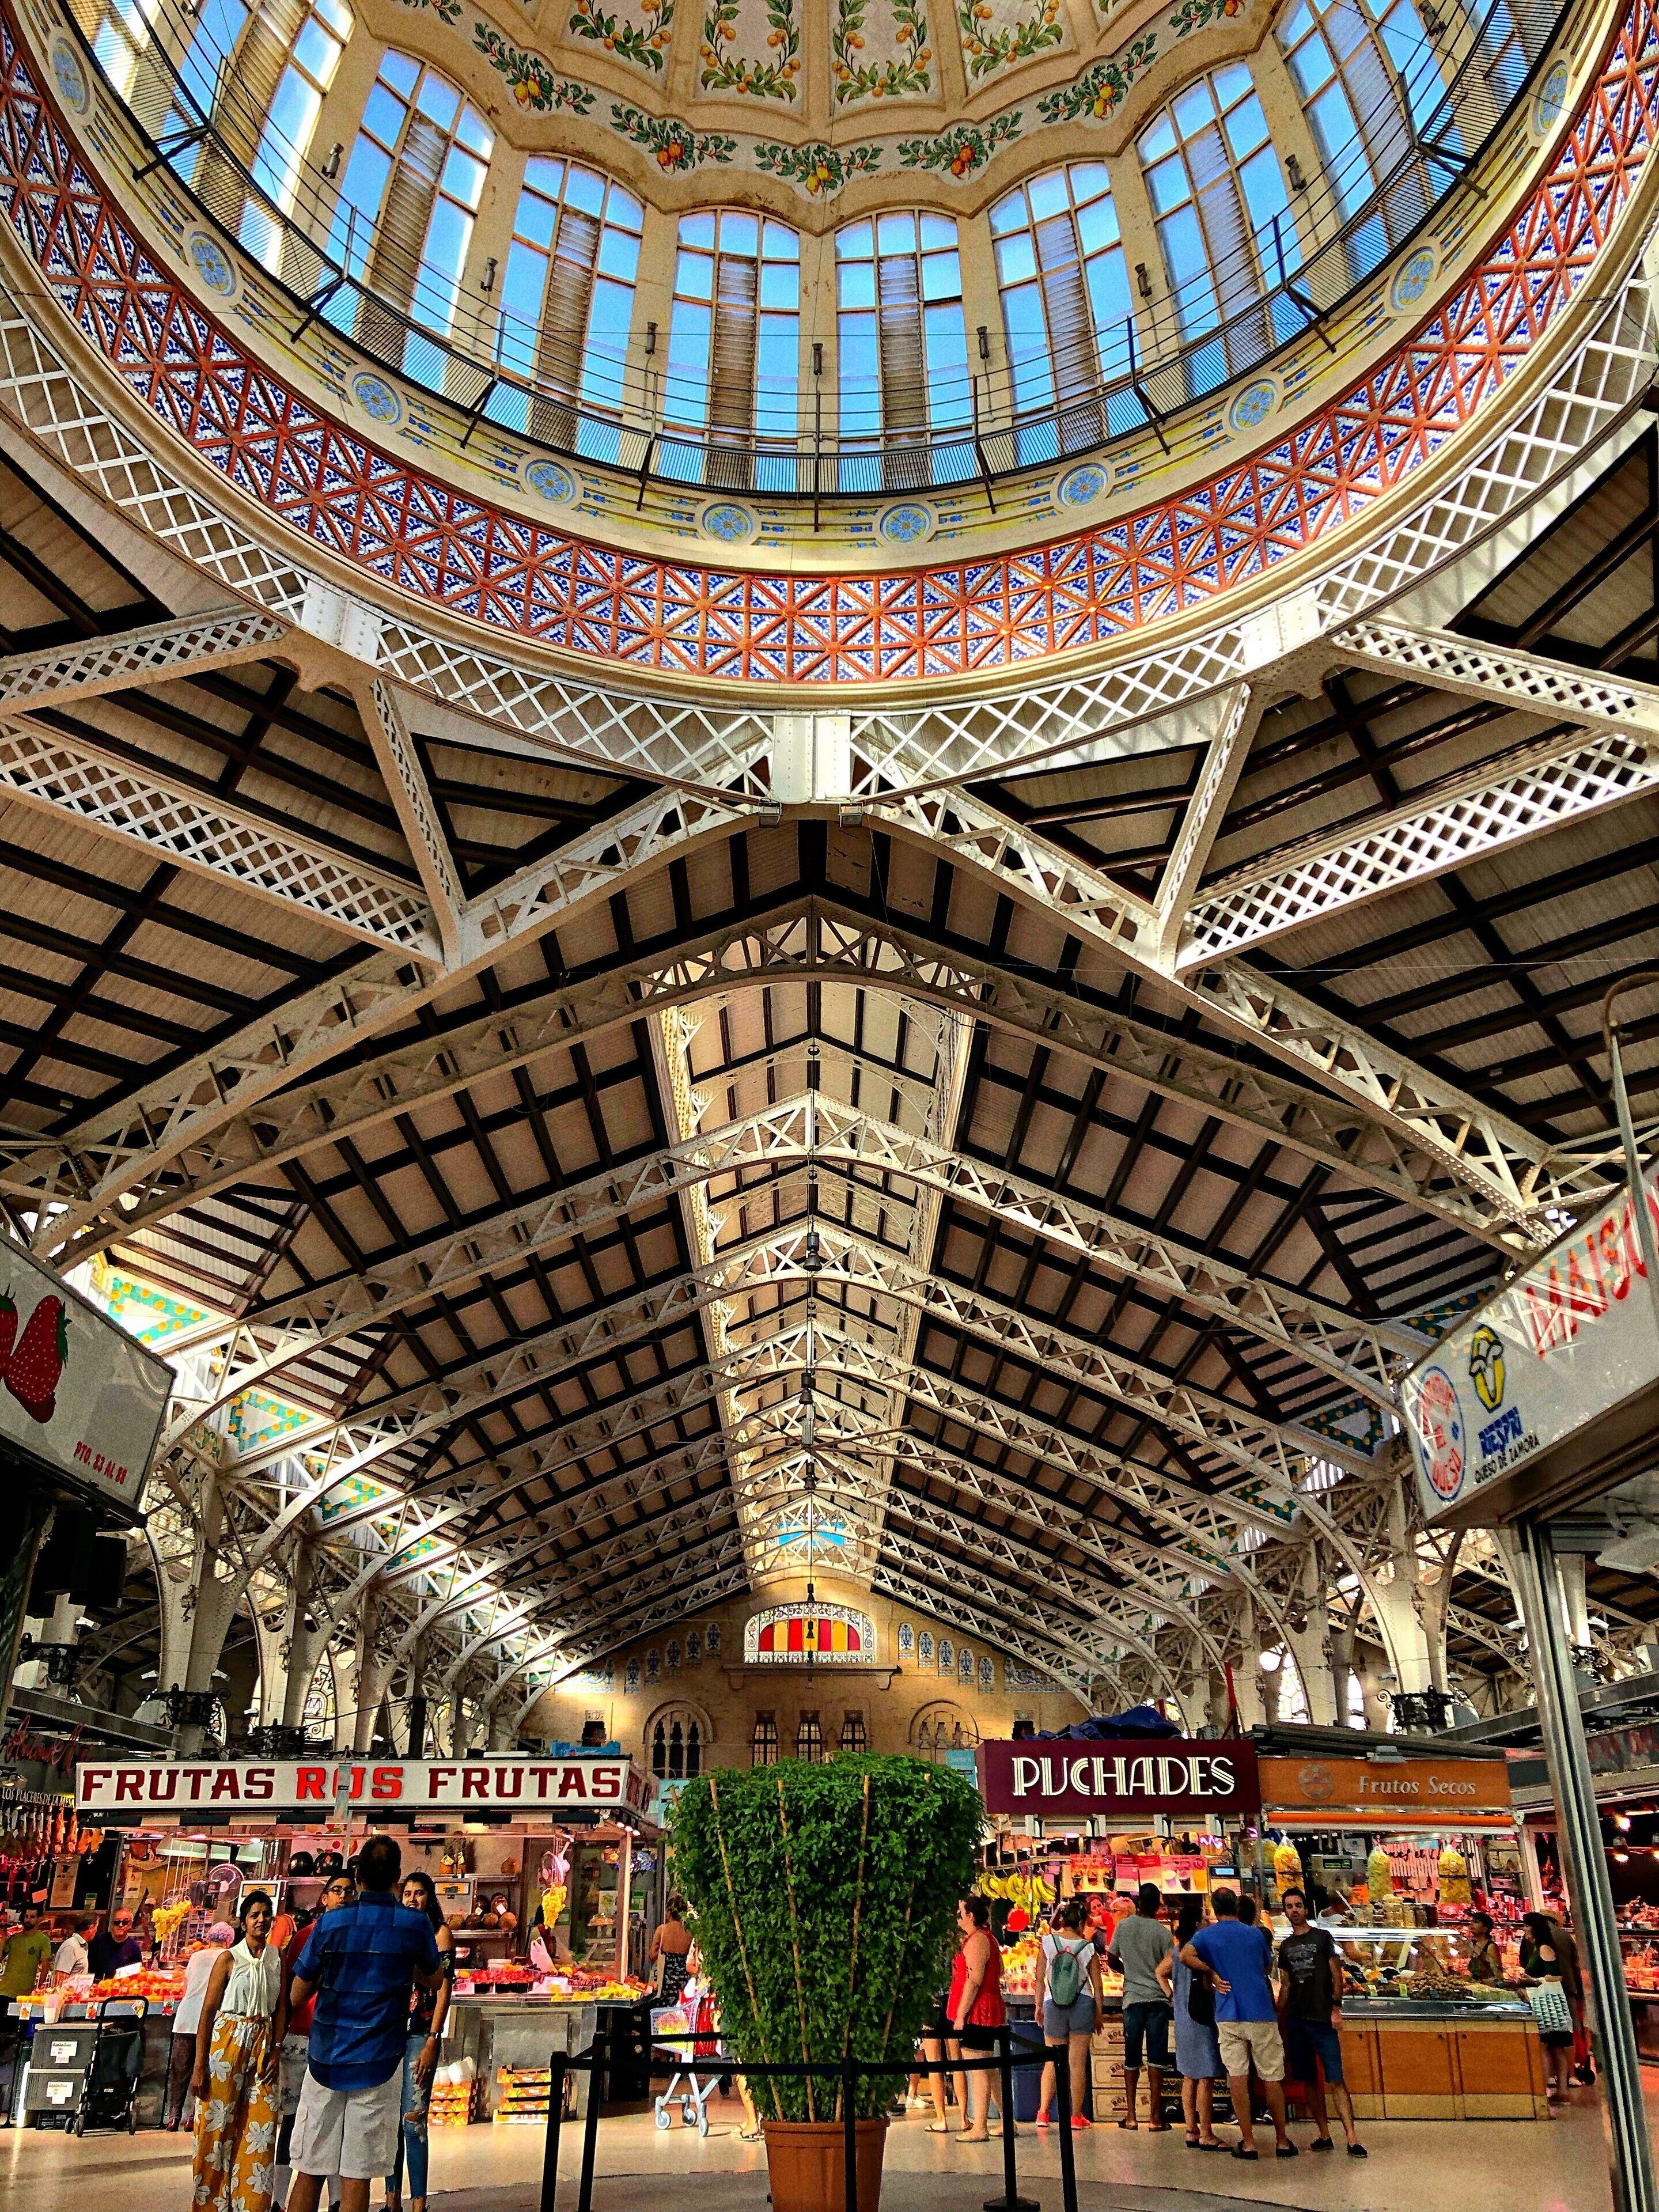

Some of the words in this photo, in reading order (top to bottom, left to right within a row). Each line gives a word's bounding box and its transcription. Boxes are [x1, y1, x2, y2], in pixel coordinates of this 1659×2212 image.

[73, 1441, 92, 1465] PTO.
[104, 1460, 116, 1479] AL
[1475, 1459, 1497, 1483] QUESO
[1497, 1452, 1508, 1469] DE
[1508, 1433, 1540, 1463] ZAMORA
[81, 1768, 276, 1801] FRUTAS
[428, 1767, 622, 1798] FRUTAS
[1012, 1756, 1235, 1796] PUCHADES
[1358, 1775, 1420, 1794] Frutos
[1428, 1775, 1476, 1795] Secos
[2, 1786, 14, 1801] LOS
[1108, 2030, 1122, 2040] BOL
[1112, 2097, 1125, 2107] BOL
